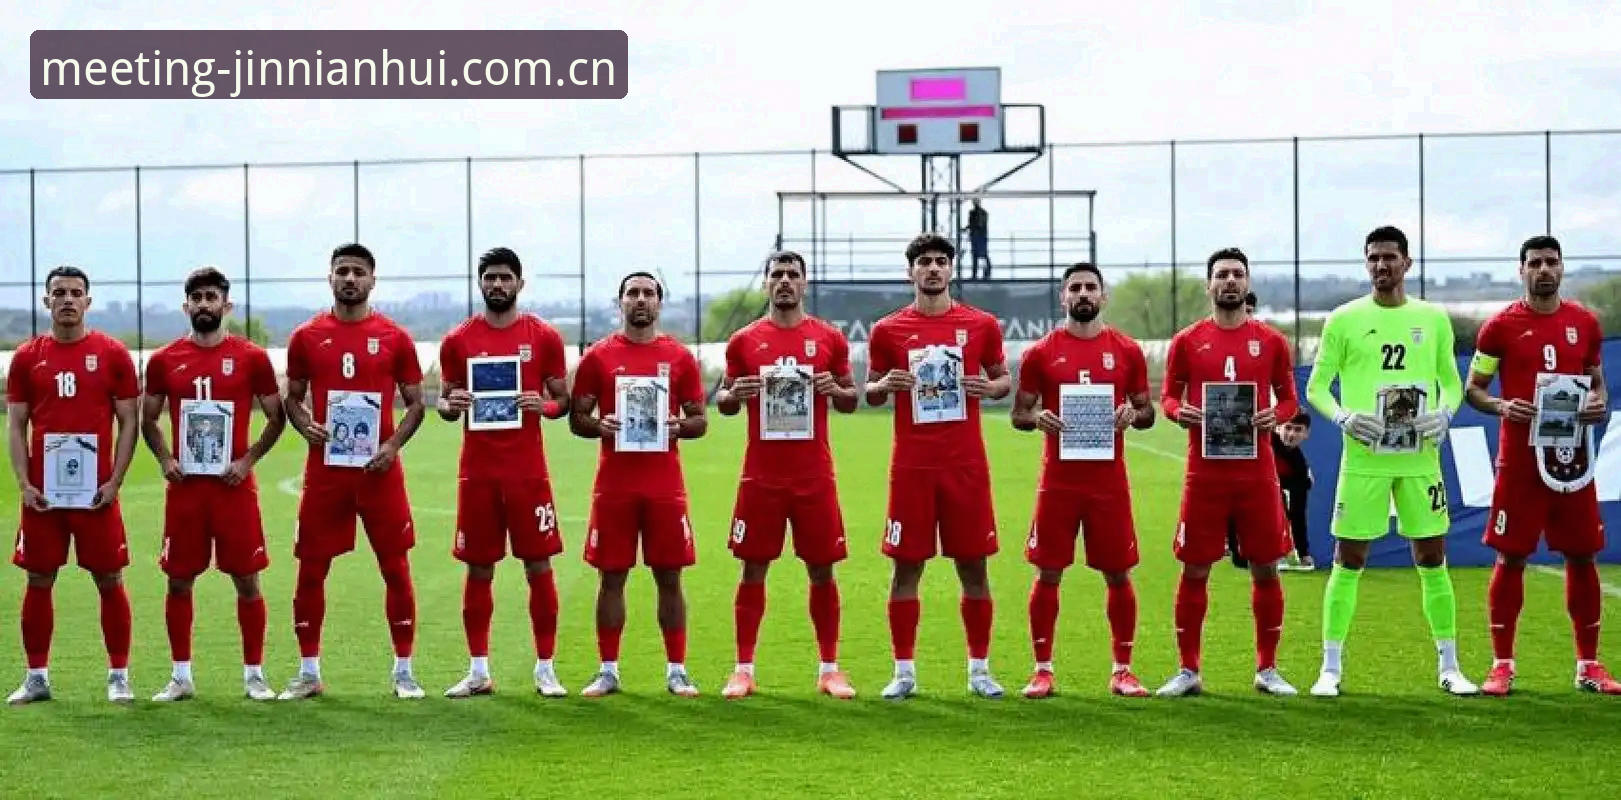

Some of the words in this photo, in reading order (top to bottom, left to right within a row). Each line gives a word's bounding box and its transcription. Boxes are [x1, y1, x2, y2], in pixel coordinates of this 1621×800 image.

[342, 352, 356, 379] 8
[1223, 355, 1237, 382] 4
[1381, 342, 1406, 370] 22
[1543, 345, 1557, 370] 9
[54, 371, 77, 401] 18
[192, 375, 212, 401] 11
[1494, 509, 1507, 535] 9
